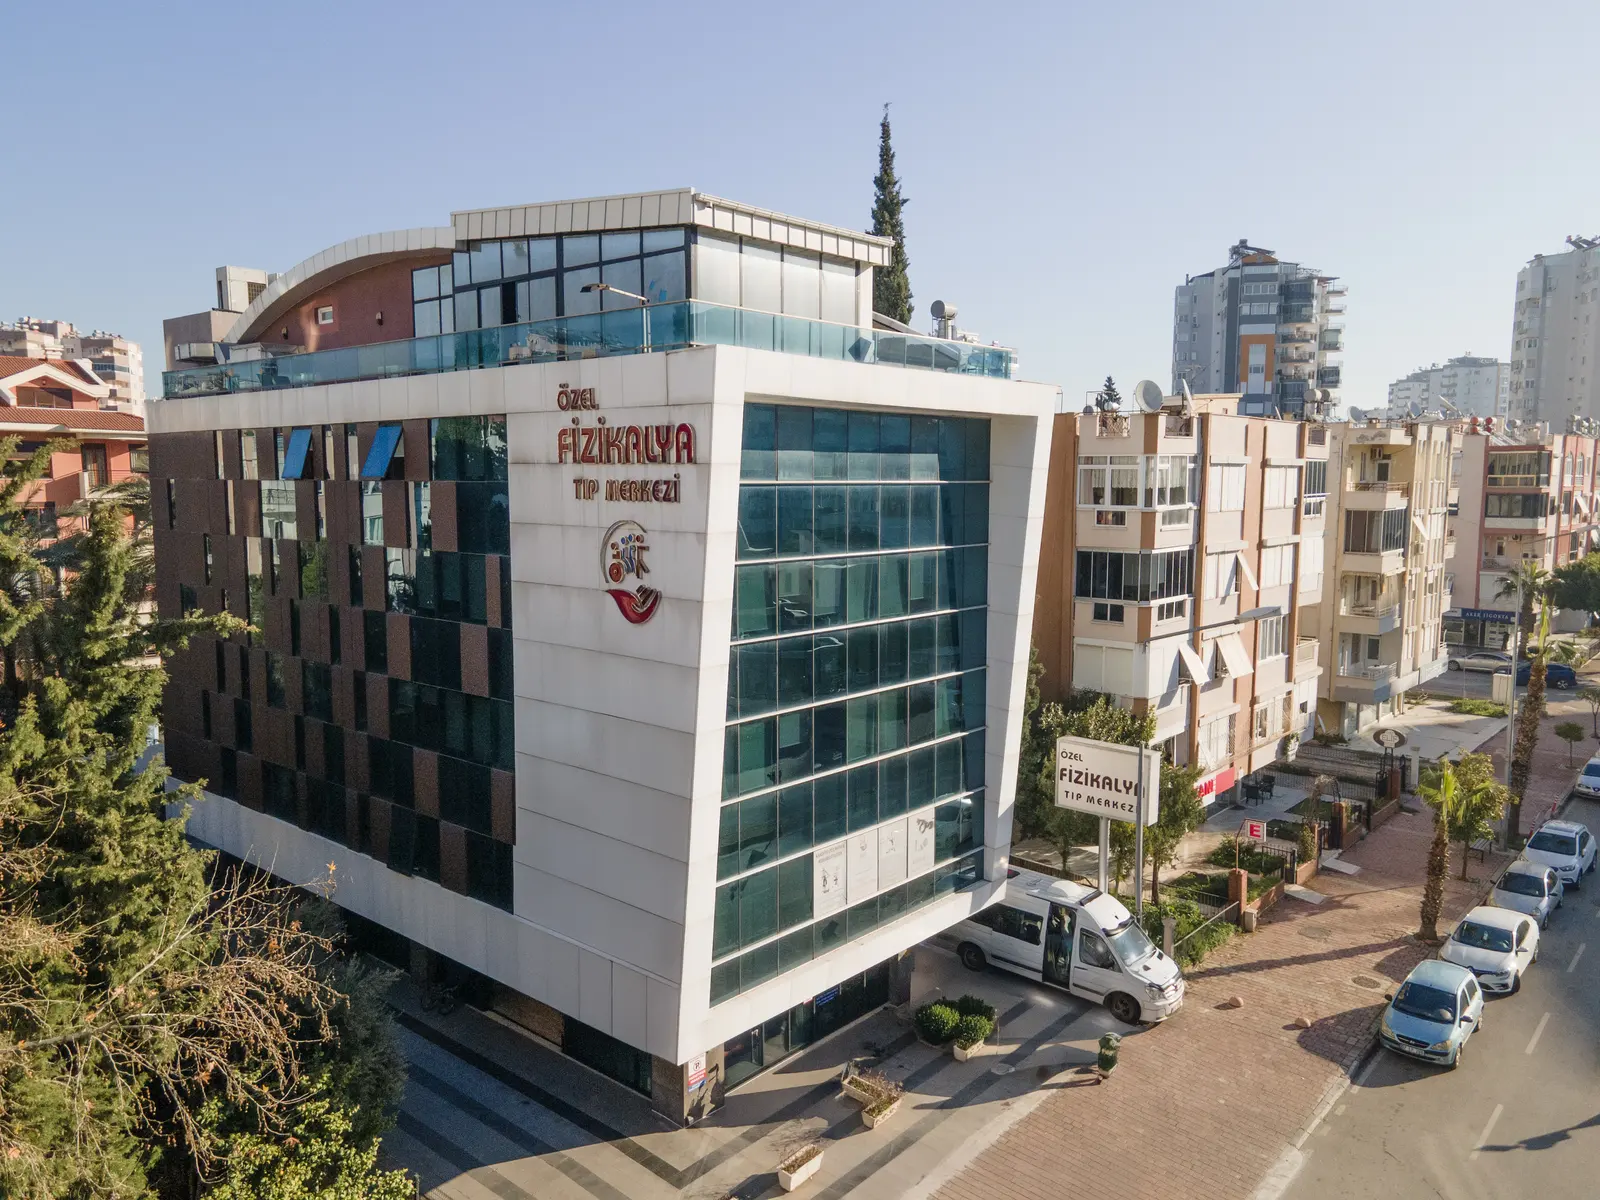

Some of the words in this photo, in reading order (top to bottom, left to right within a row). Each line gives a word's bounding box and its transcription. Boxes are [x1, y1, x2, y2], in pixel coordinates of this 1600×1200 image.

[557, 383, 599, 411] ÖZEL
[557, 416, 697, 464] FİZİKALYA
[573, 478, 599, 500] TIP
[605, 473, 681, 503] MERKEZİ
[1060, 748, 1084, 762] ÖZEL
[1064, 790, 1082, 801] TIP
[1086, 795, 1138, 814] MERKEZ
[1250, 823, 1261, 838] E
